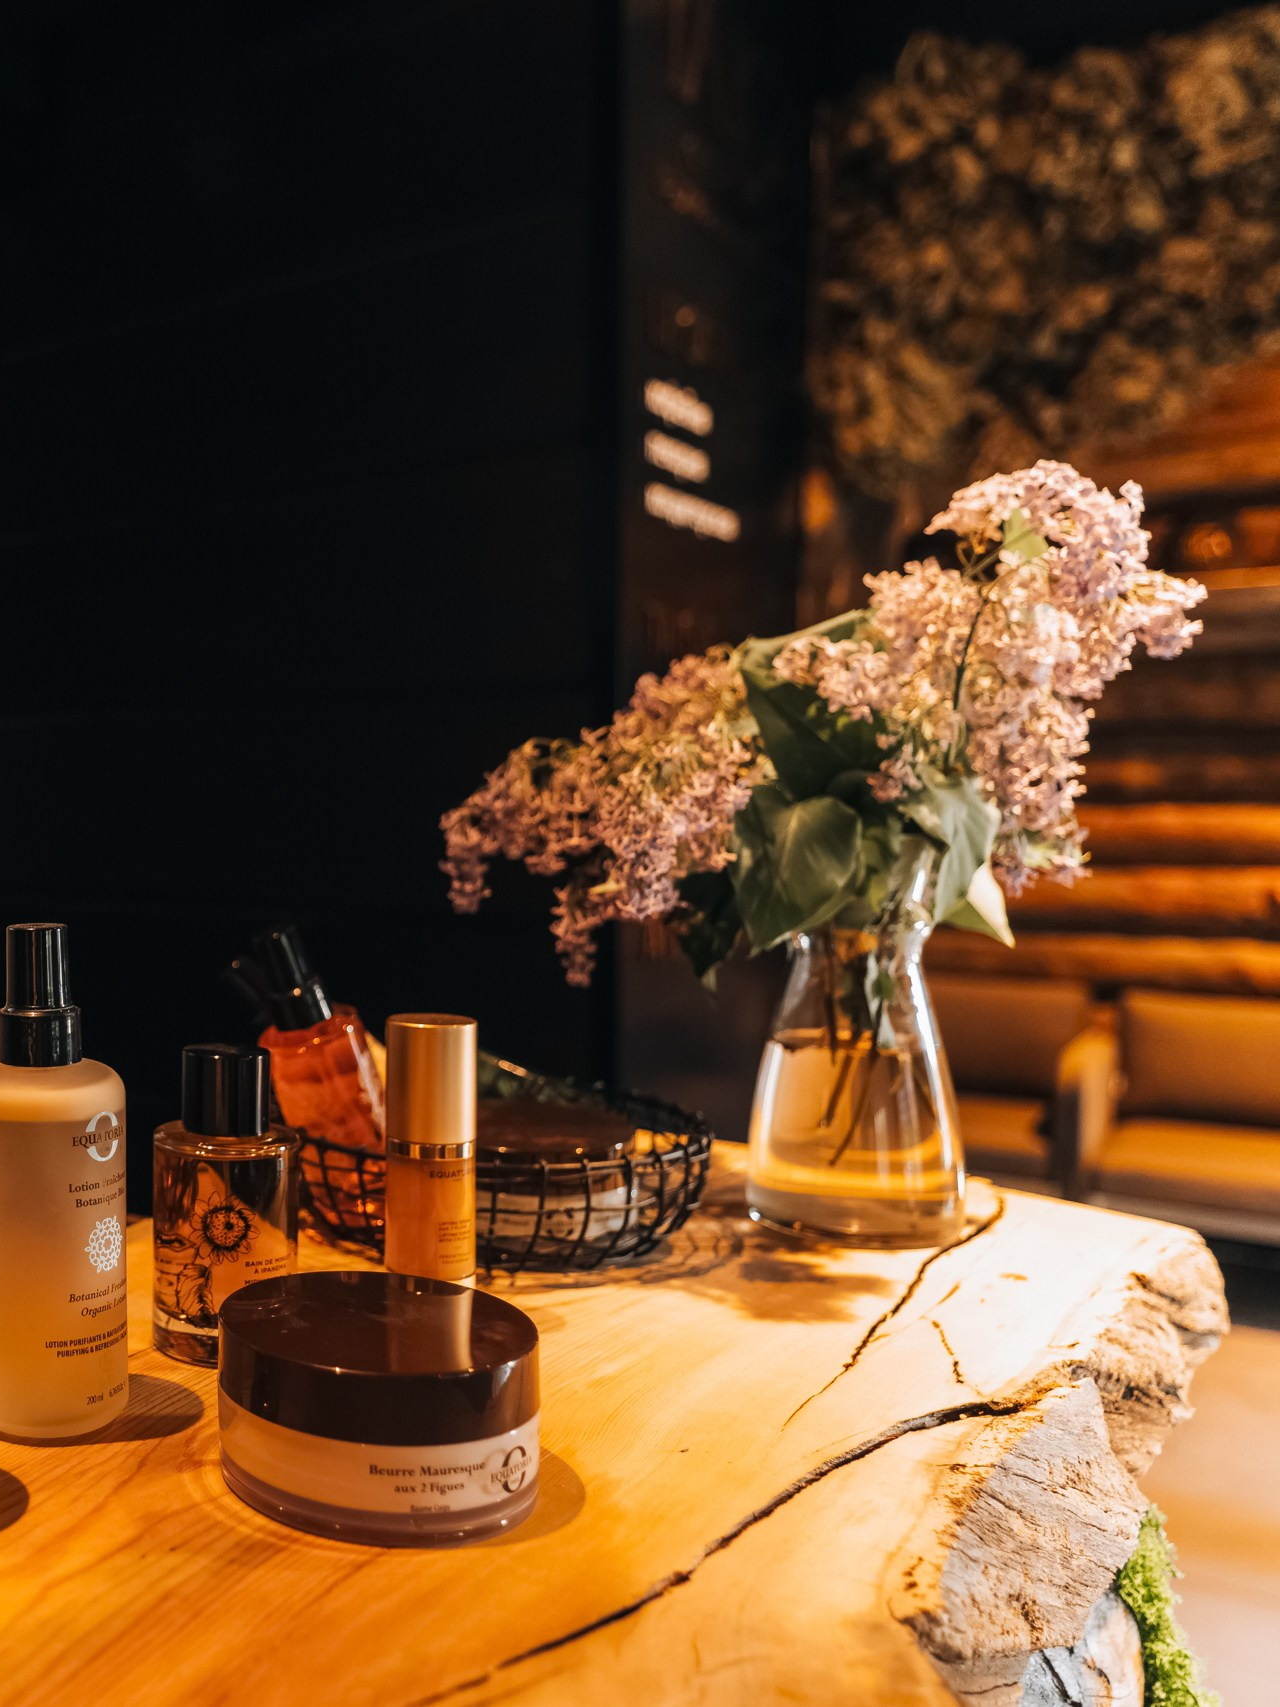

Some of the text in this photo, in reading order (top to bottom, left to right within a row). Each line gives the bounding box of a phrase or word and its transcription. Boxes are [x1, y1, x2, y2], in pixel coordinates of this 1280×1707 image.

[69, 1181, 100, 1193] Lotion
[75, 1191, 117, 1208] Botanique
[69, 1285, 110, 1303] Botanical
[81, 1300, 112, 1318] Organic
[45, 1340, 68, 1349] LOTION
[69, 1333, 102, 1347] PURIFIANTE
[102, 1332, 107, 1340] &
[57, 1347, 89, 1358] PURIFYING
[90, 1345, 94, 1353] &
[370, 1461, 486, 1477] Beurre Mauresque
[394, 1482, 465, 1496] aux 2 Figues
